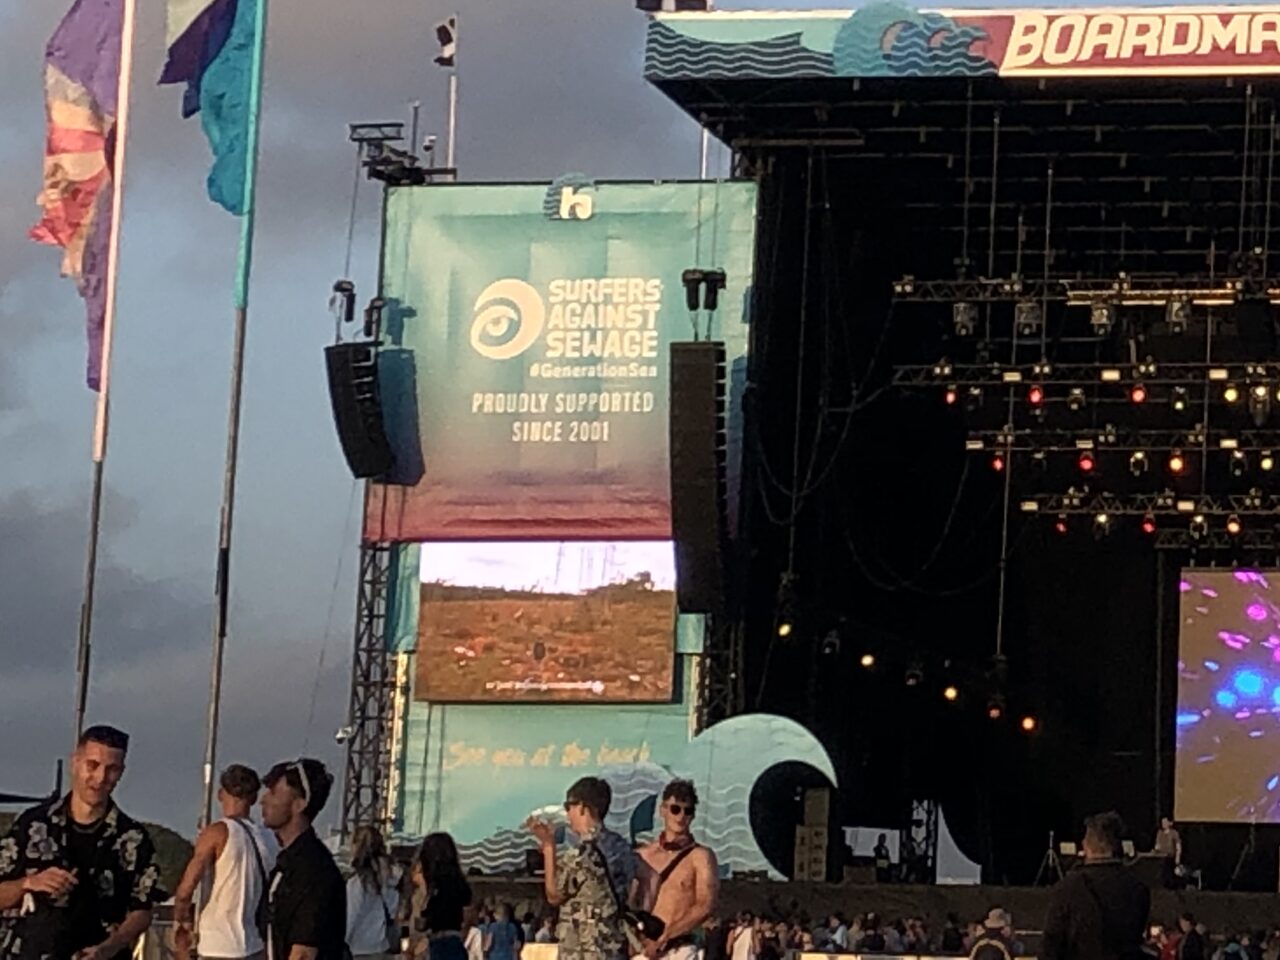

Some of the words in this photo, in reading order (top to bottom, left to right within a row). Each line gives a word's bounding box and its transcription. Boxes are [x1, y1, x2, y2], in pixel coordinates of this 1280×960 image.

[548, 278, 661, 303] SURFERS
[547, 303, 661, 330] AGAINST
[546, 330, 658, 358] SEWAGE
[529, 362, 657, 378] #GenerationSea
[472, 392, 549, 413] PROUDLY
[555, 391, 654, 413] SUPPORTED
[512, 421, 563, 442] SINCE
[569, 421, 609, 442] 2001
